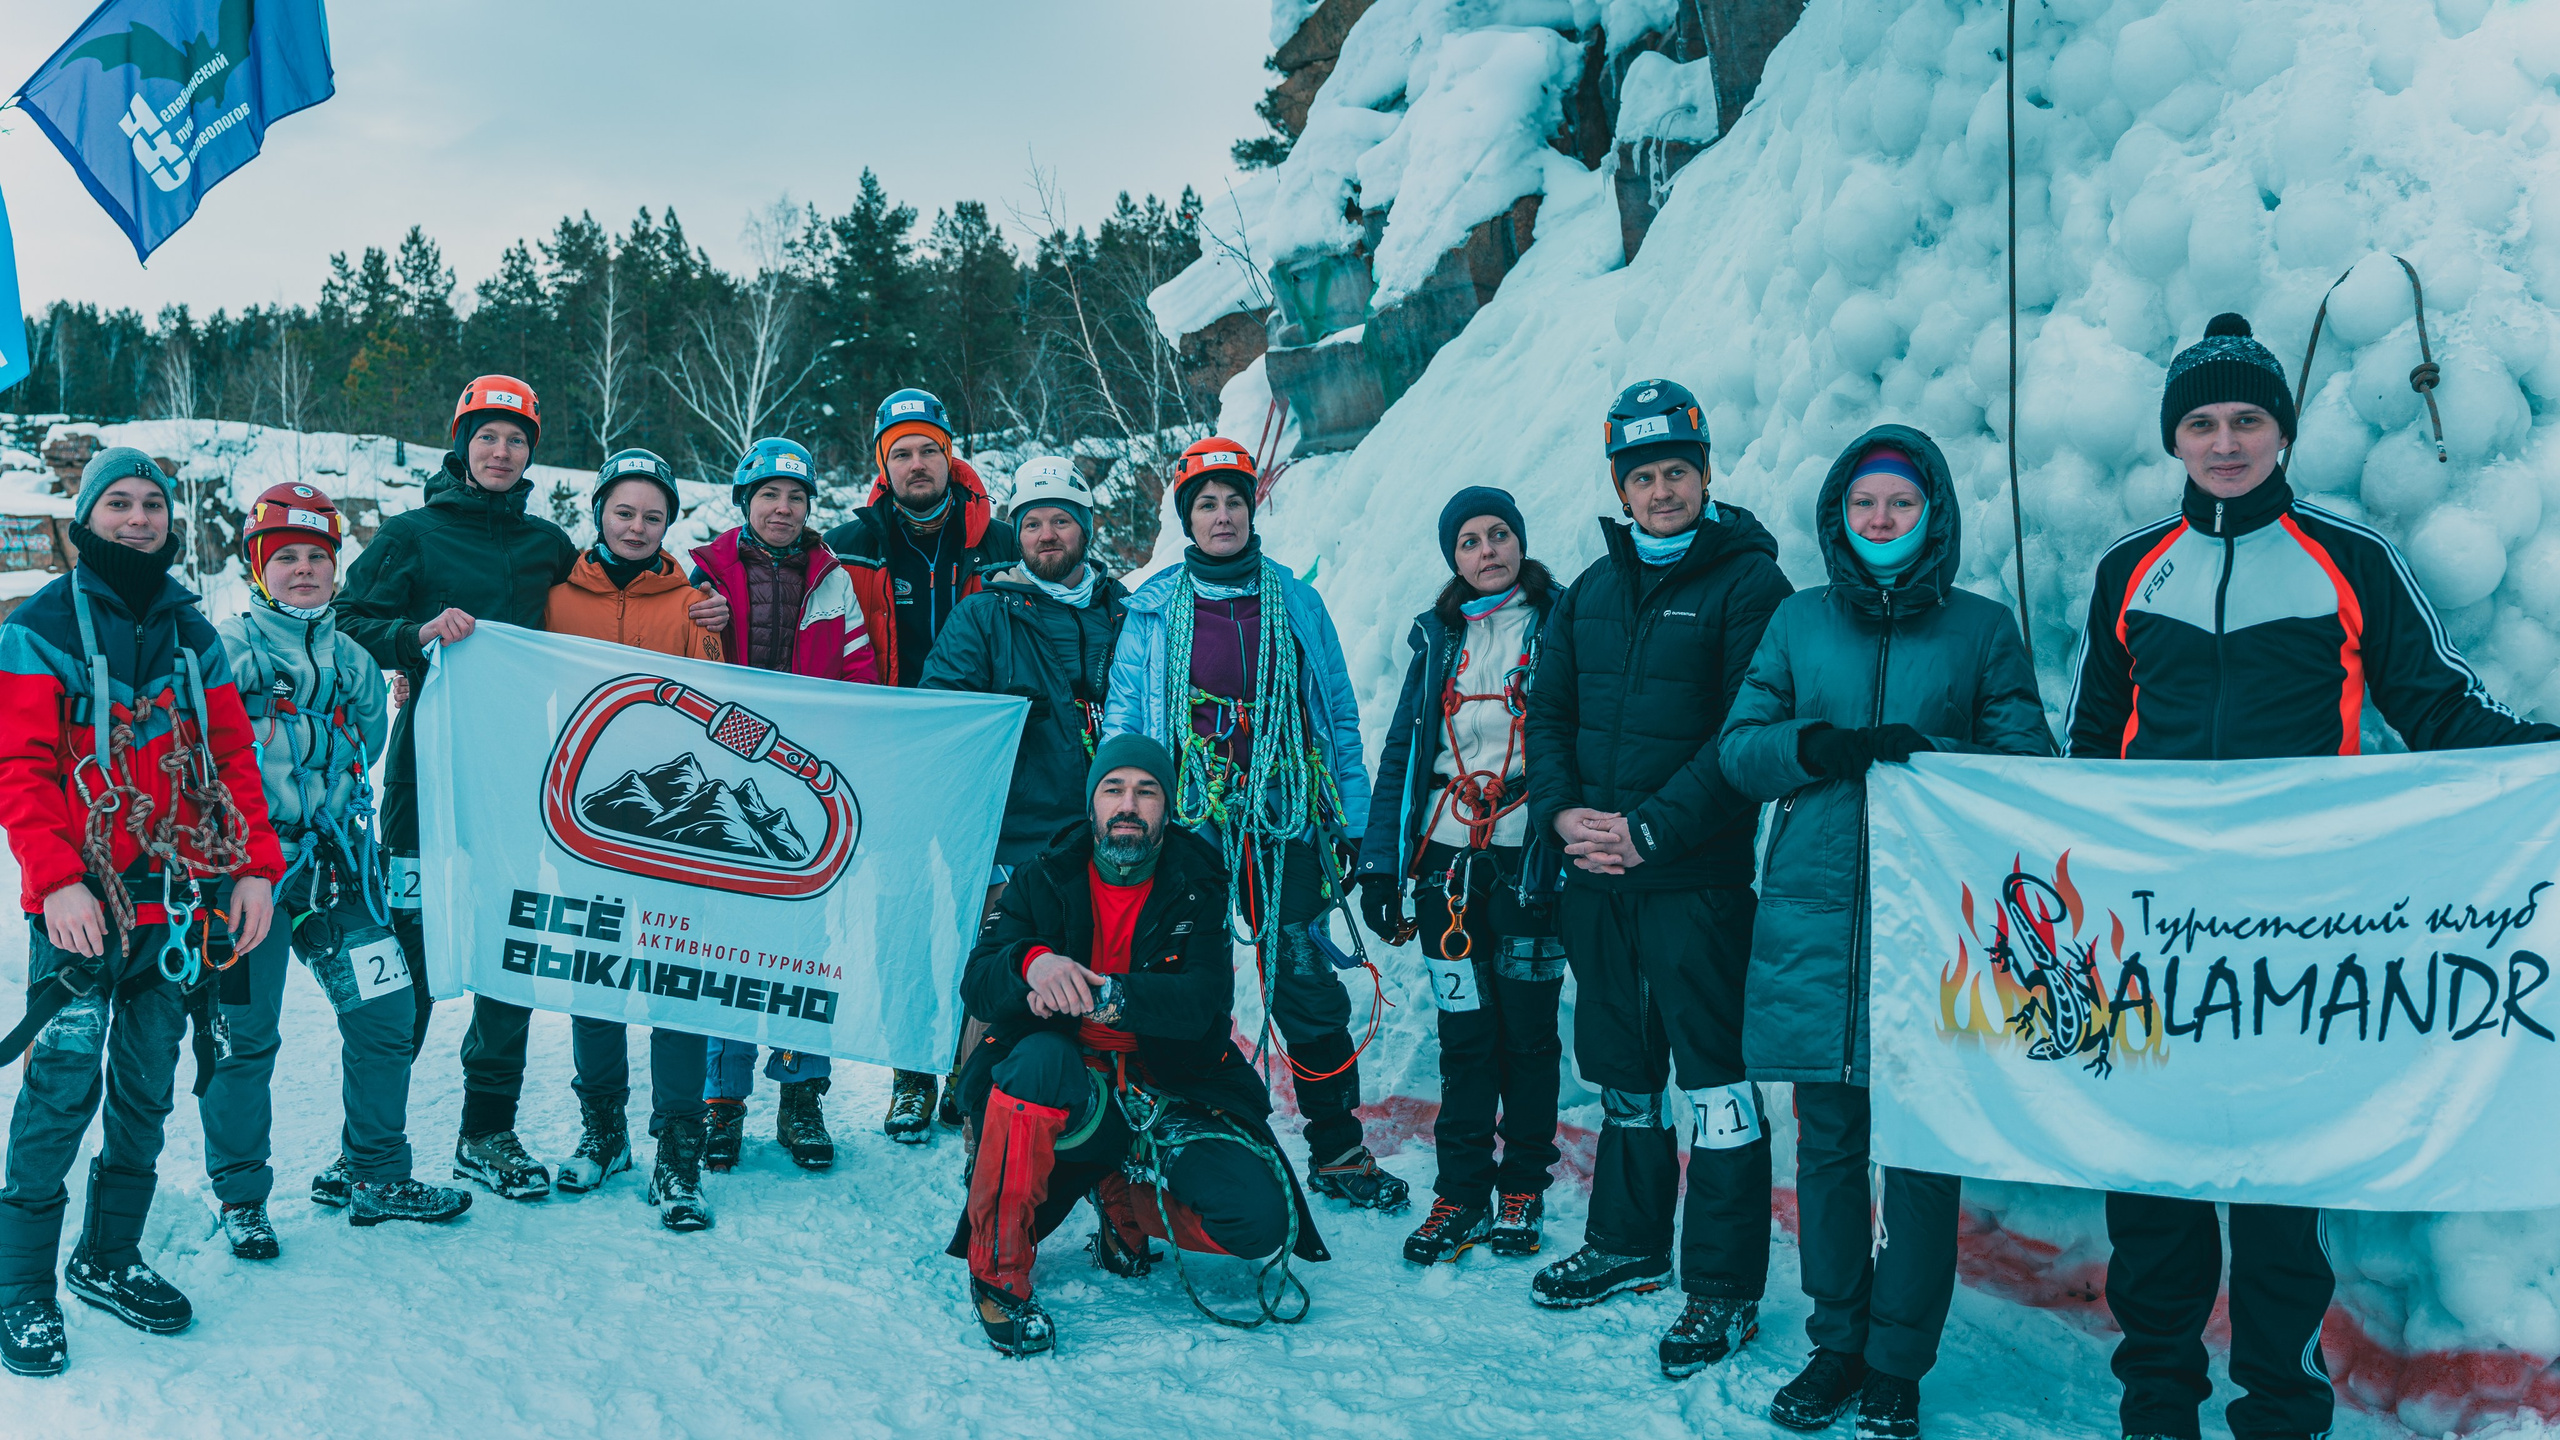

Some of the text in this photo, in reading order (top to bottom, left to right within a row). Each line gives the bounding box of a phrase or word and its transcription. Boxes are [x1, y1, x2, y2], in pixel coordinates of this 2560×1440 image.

[496, 393, 514, 404] 4.2
[900, 402, 915, 411] 6.1
[1635, 421, 1656, 436] 7.1
[628, 460, 645, 469] 4.1
[785, 461, 800, 471] 6.2
[1213, 454, 1228, 462] 1.2
[1042, 467, 1057, 476] 1.1
[301, 513, 318, 526] 2.1
[1095, 643, 1110, 691] ALOMON
[508, 889, 626, 943] ВСЁ
[642, 911, 690, 931] КЛУБ
[2131, 880, 2555, 955] Туристский клуб
[637, 932, 843, 980] АКТИВНОГО ТУРИЗМА
[368, 947, 408, 986] 2.1
[502, 938, 839, 1025] ВЫКЛЮЧЕНО
[1694, 1098, 1749, 1136] 7.1
